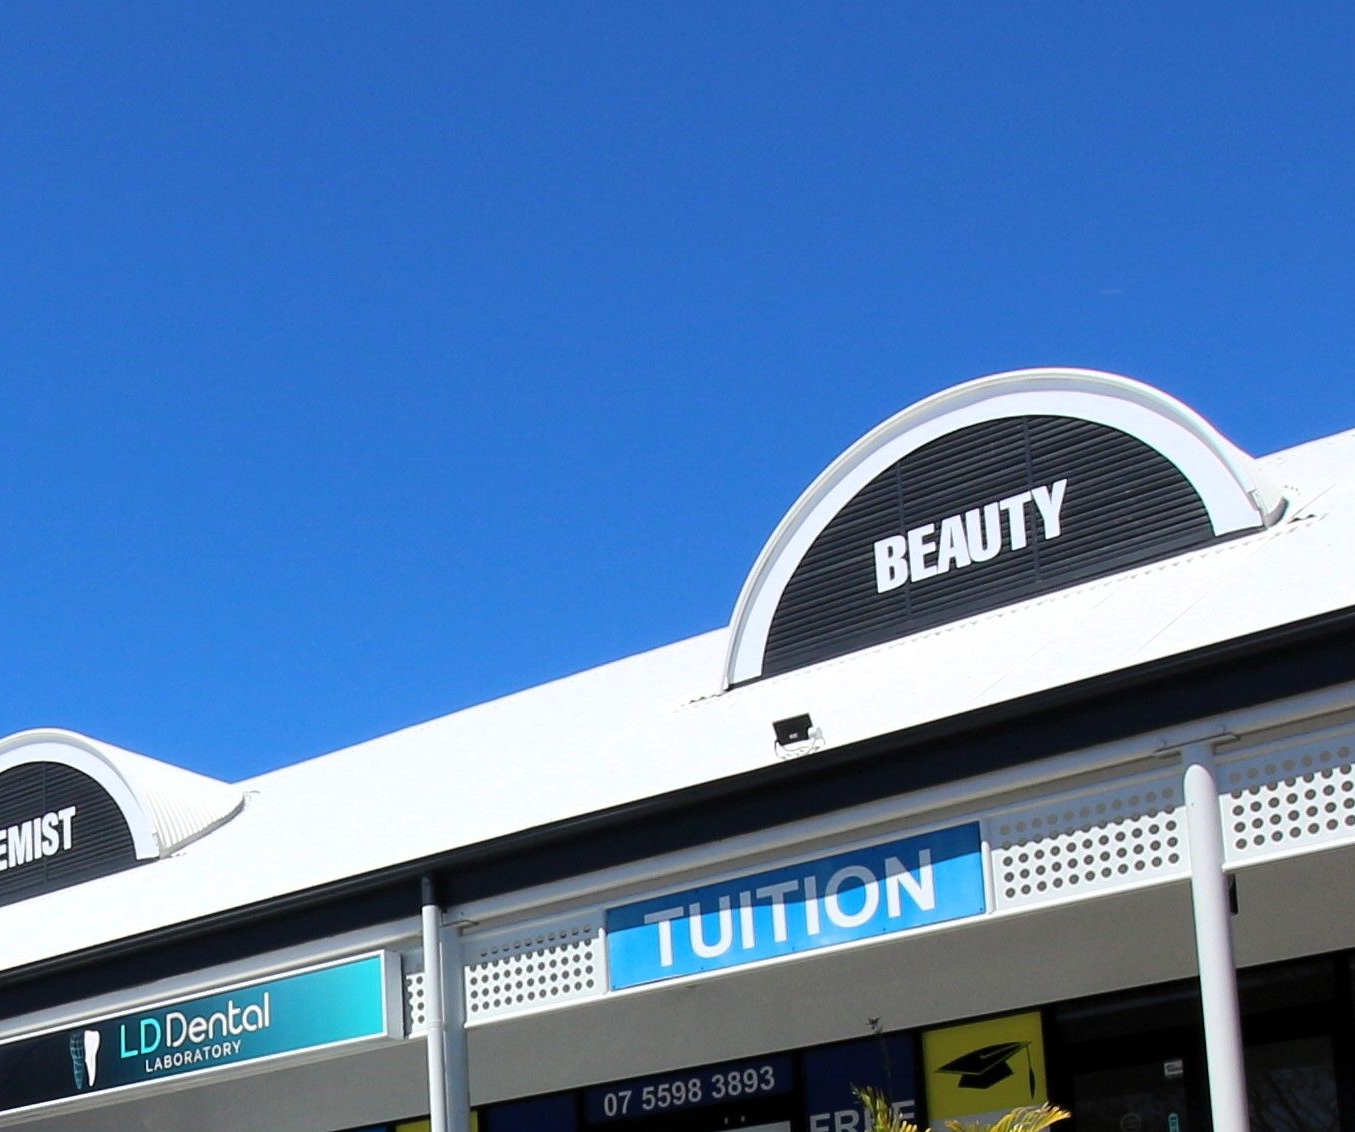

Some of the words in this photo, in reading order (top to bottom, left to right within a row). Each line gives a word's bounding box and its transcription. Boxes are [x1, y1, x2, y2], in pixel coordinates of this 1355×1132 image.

[873, 478, 1068, 594] BEAUTY
[644, 848, 937, 968] TUITION
[166, 991, 270, 1048] Dental
[145, 1039, 242, 1073] LABORATORY
[603, 1089, 632, 1117] 07
[641, 1078, 702, 1111] 5598
[711, 1065, 775, 1099] 3893
